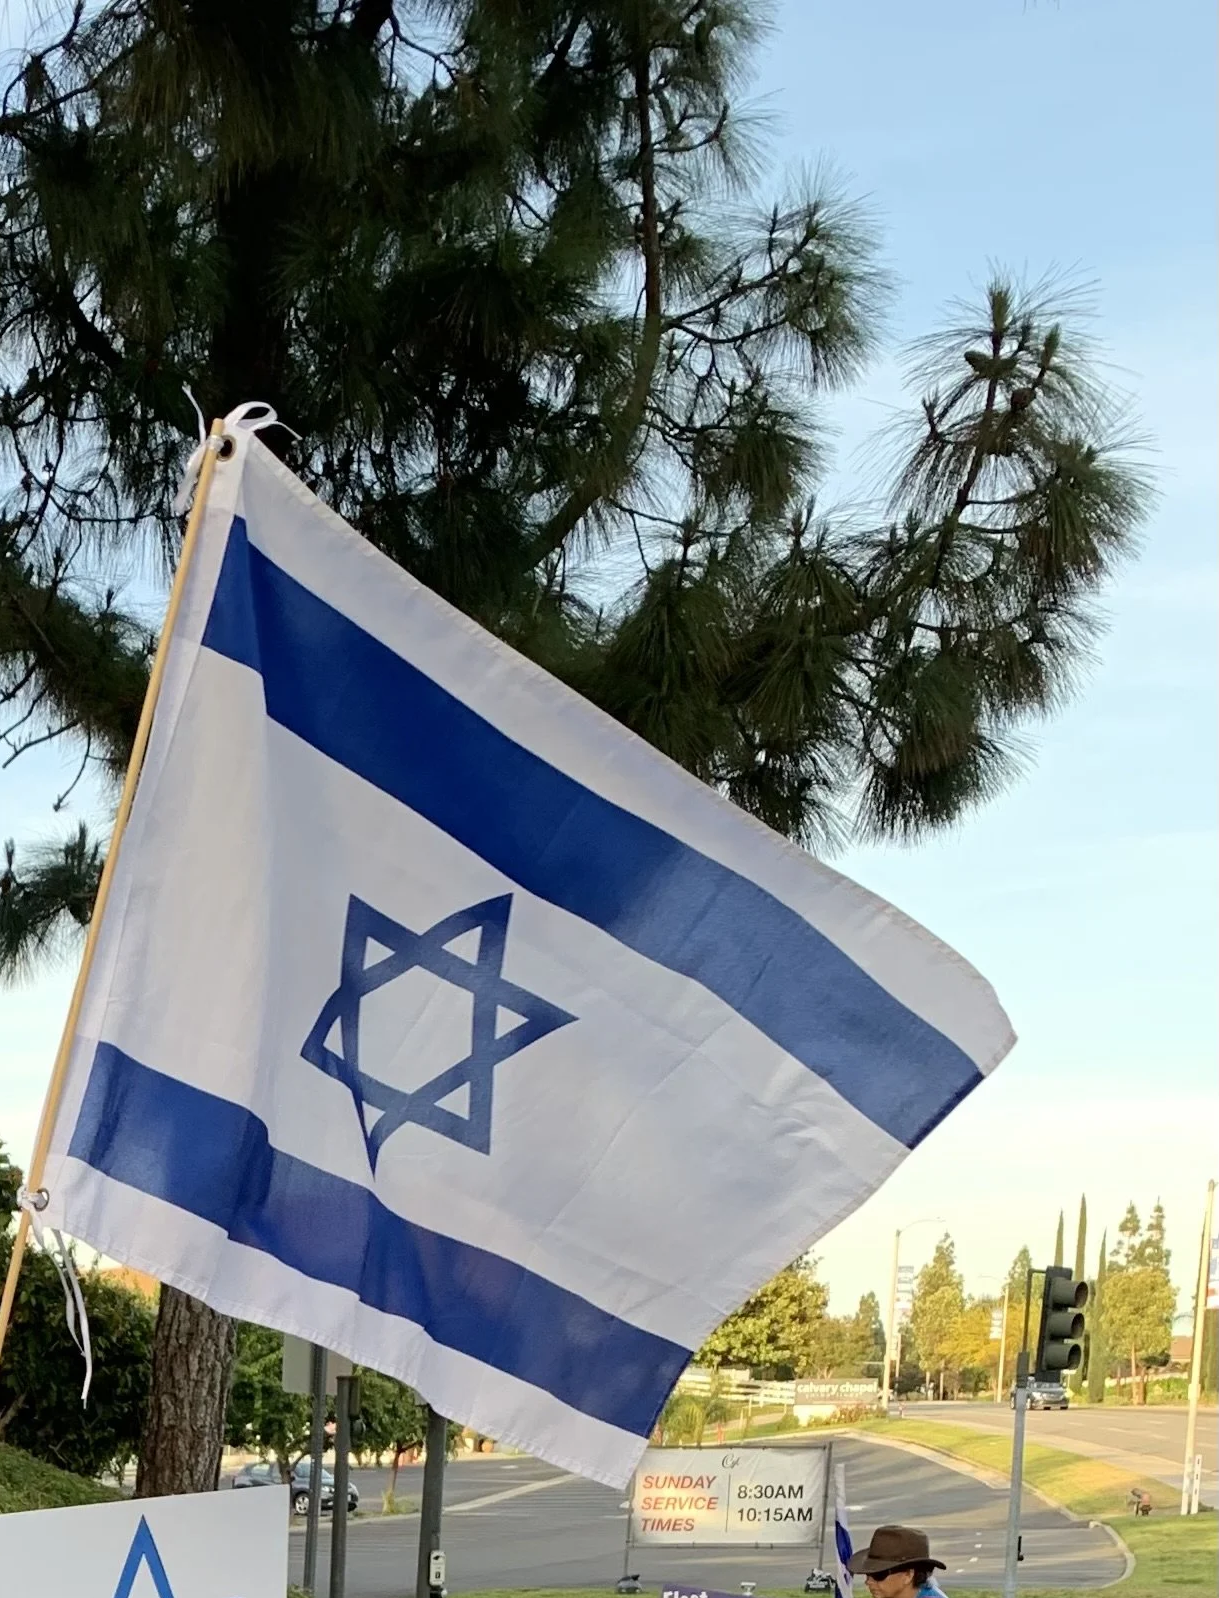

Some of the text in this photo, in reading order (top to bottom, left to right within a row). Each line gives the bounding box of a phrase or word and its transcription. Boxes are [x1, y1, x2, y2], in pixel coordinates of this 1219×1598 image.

[642, 1475, 716, 1489] SUNDAY
[737, 1484, 804, 1499] 8:30AM
[641, 1497, 719, 1510] SERVICE
[737, 1507, 813, 1522] 10:15AM
[642, 1518, 695, 1532] TIMES
